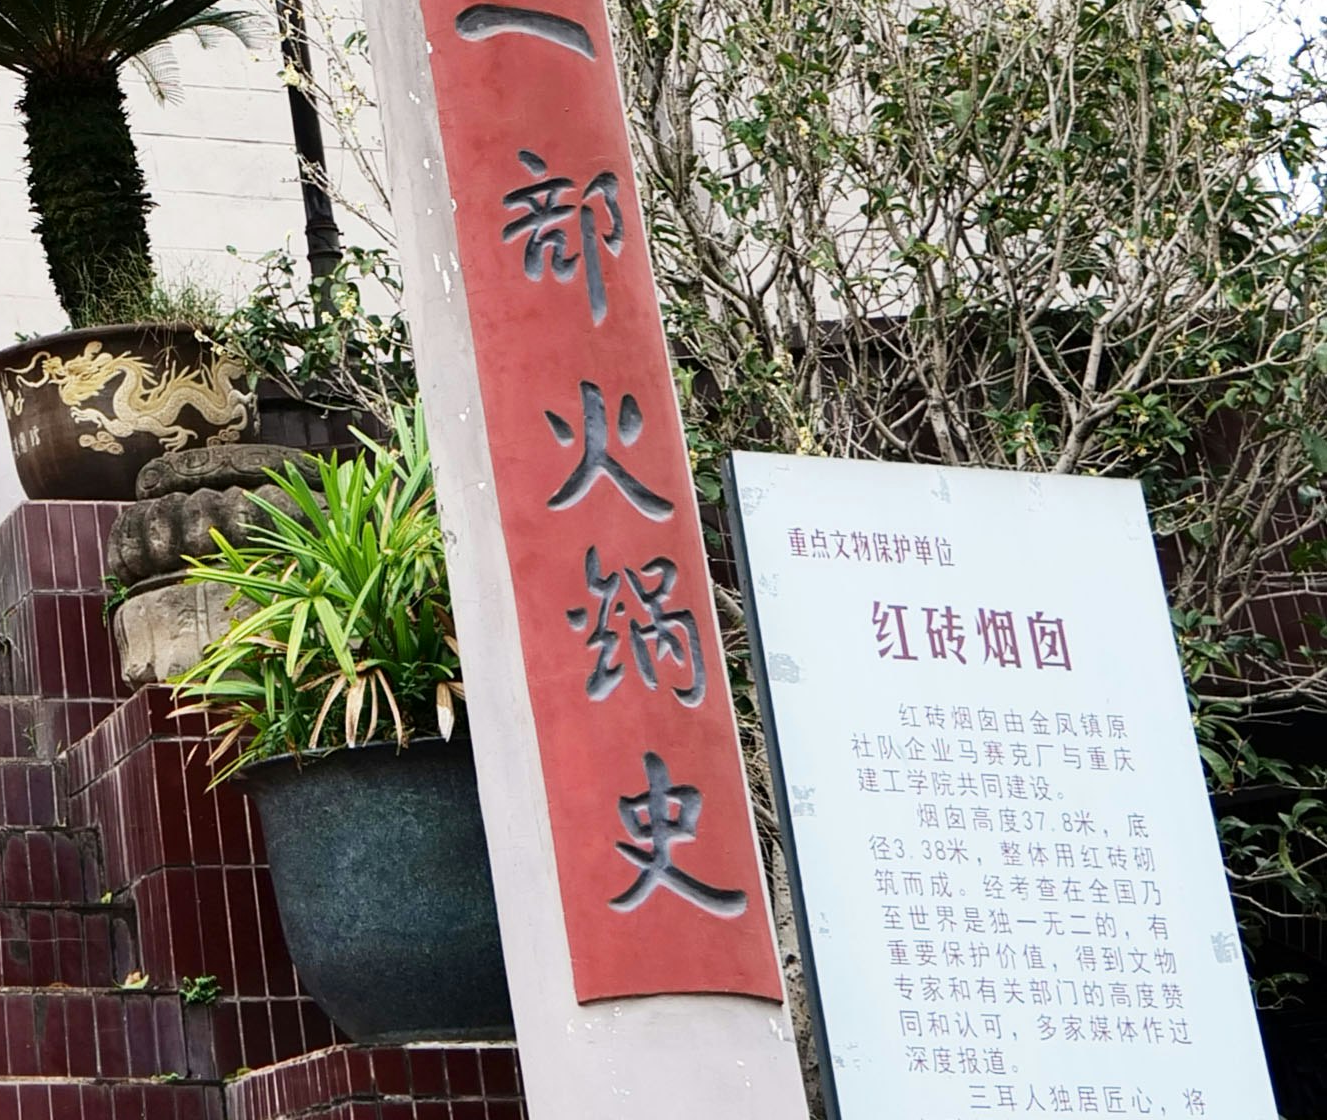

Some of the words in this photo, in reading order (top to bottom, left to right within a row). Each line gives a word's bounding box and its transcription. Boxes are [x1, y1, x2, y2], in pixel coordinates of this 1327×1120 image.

[453, 2, 748, 916] 一部火锅史
[787, 526, 956, 568] 重点文物保护单位
[871, 600, 1074, 672] 红砖烟囱
[897, 703, 1129, 740] 红砖烟囱由金凤镇原
[850, 732, 1136, 773] 社队企业马赛克厂与重庆
[856, 767, 1065, 802] 建工学院共同建设。
[873, 868, 1162, 907] 筑而成。经考查在全国乃
[881, 904, 1170, 941] 至世界是独一无二的，有
[886, 939, 1178, 975] 重要保护价值，得到文物
[893, 972, 1185, 1010] 专家和有关部门的高度赞
[899, 1009, 1194, 1046] 同和认可，多家媒体作过
[905, 1044, 1021, 1076] 深度报道。
[968, 1083, 1207, 1116] 三耳人独居匠心，将
